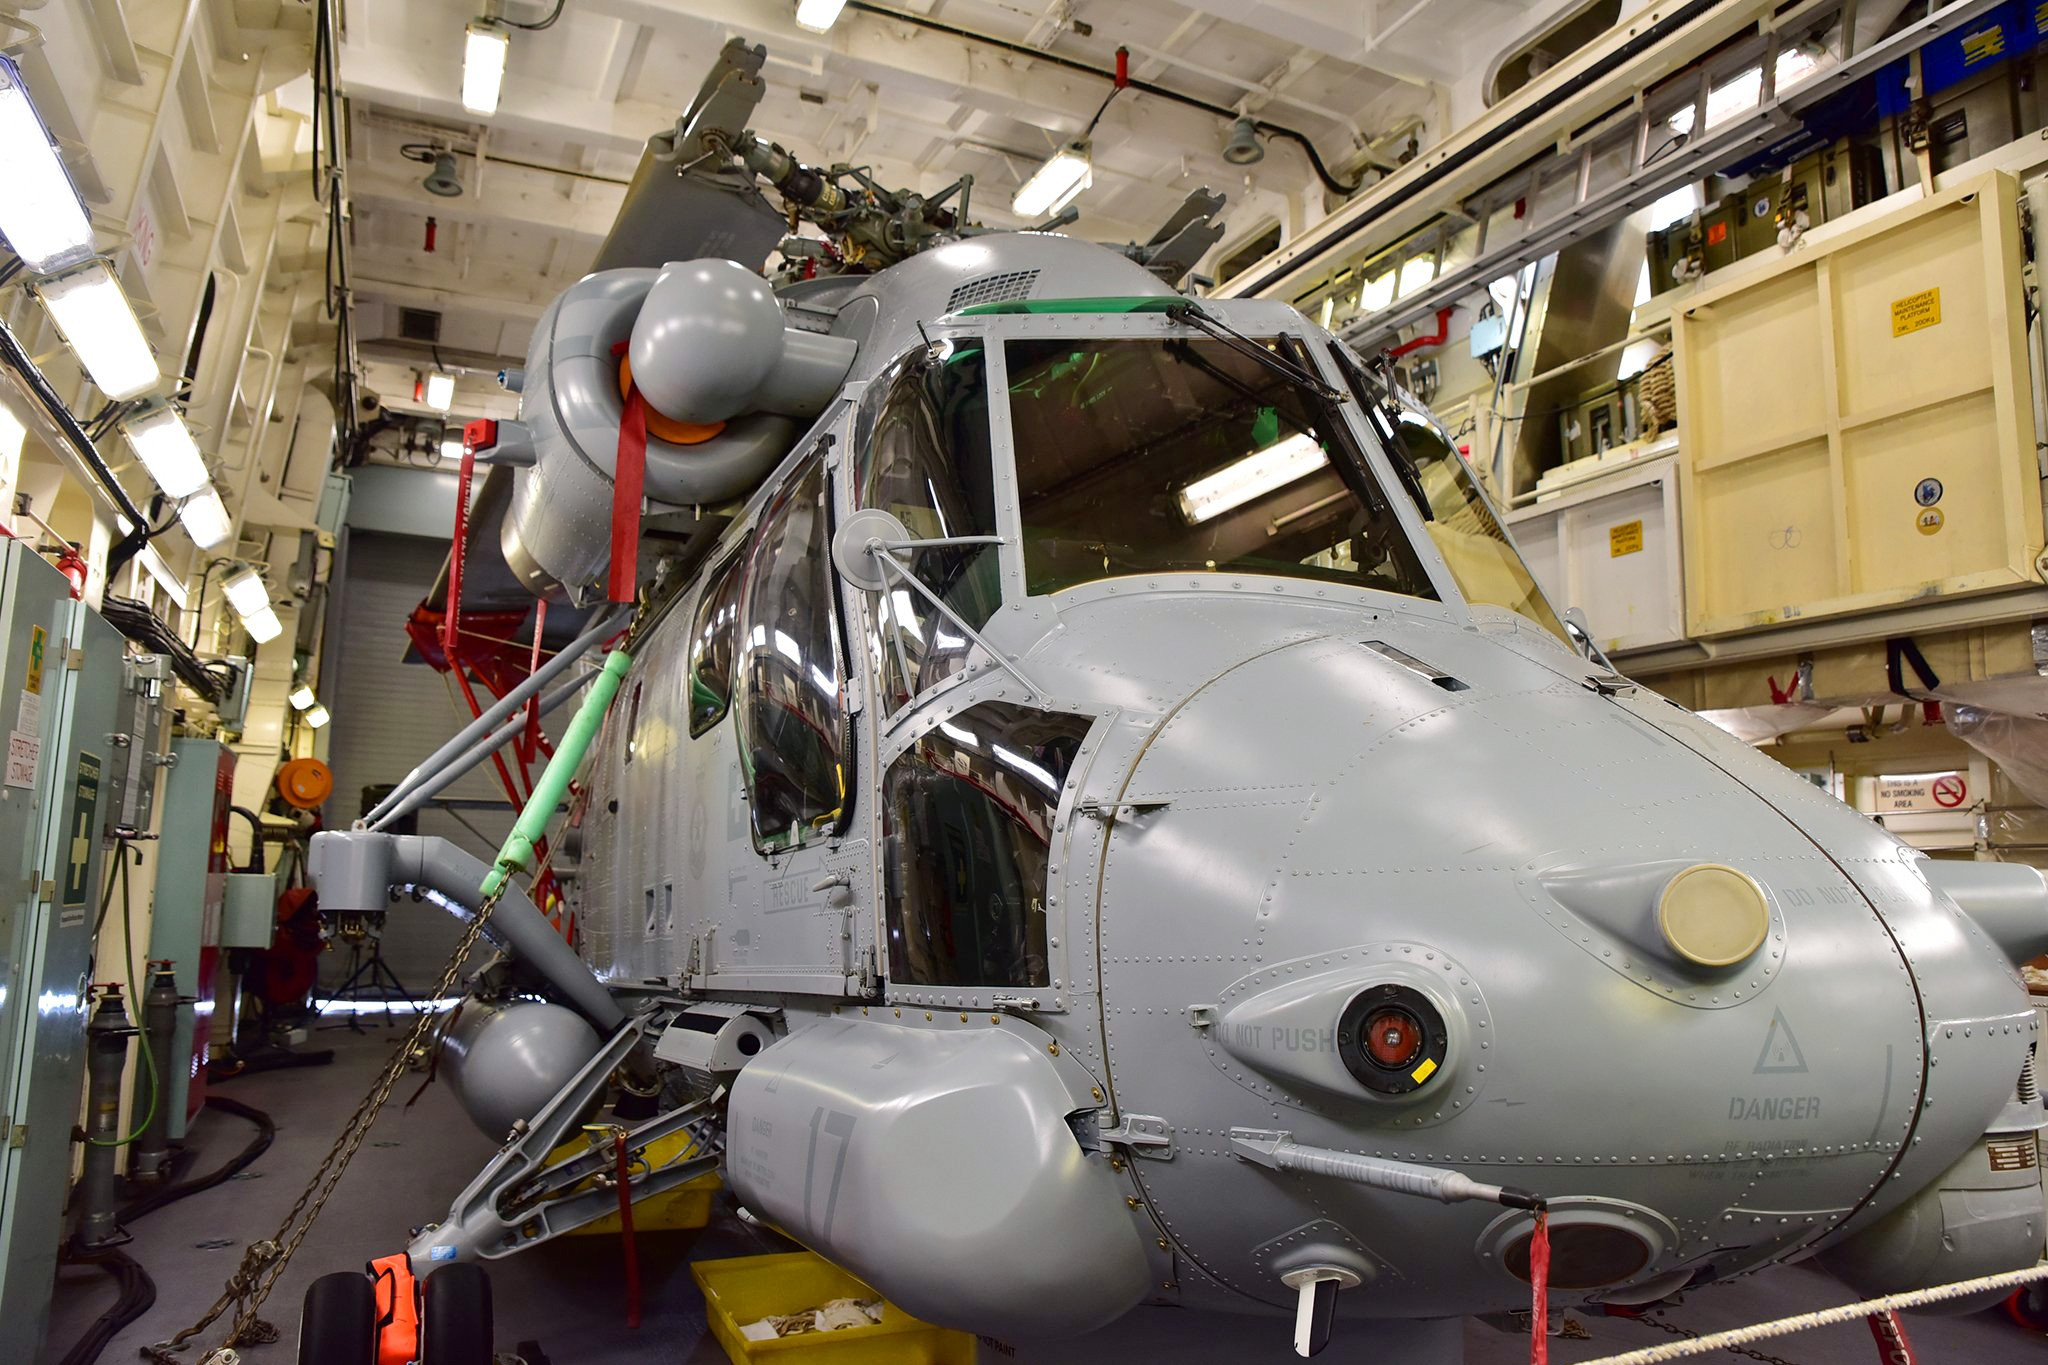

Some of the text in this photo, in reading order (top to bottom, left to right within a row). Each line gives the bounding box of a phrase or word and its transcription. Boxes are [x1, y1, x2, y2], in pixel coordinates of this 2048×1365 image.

[1895, 291, 1932, 309] HELICOPTER
[1900, 307, 1931, 321] PLATFORM
[11, 738, 40, 761] STRETCHER
[10, 762, 35, 784] STORAGE
[78, 761, 100, 781] STRETCHER
[1881, 788, 1926, 798] NO SMOKING
[1893, 800, 1913, 808] AREA
[772, 876, 809, 908] RESCUE
[1782, 887, 1815, 907] DO
[1816, 886, 1857, 905] NOT
[1213, 1022, 1336, 1053] DO NOT PUSH
[1728, 1096, 1821, 1121] DANGER
[803, 1105, 858, 1246] 17
